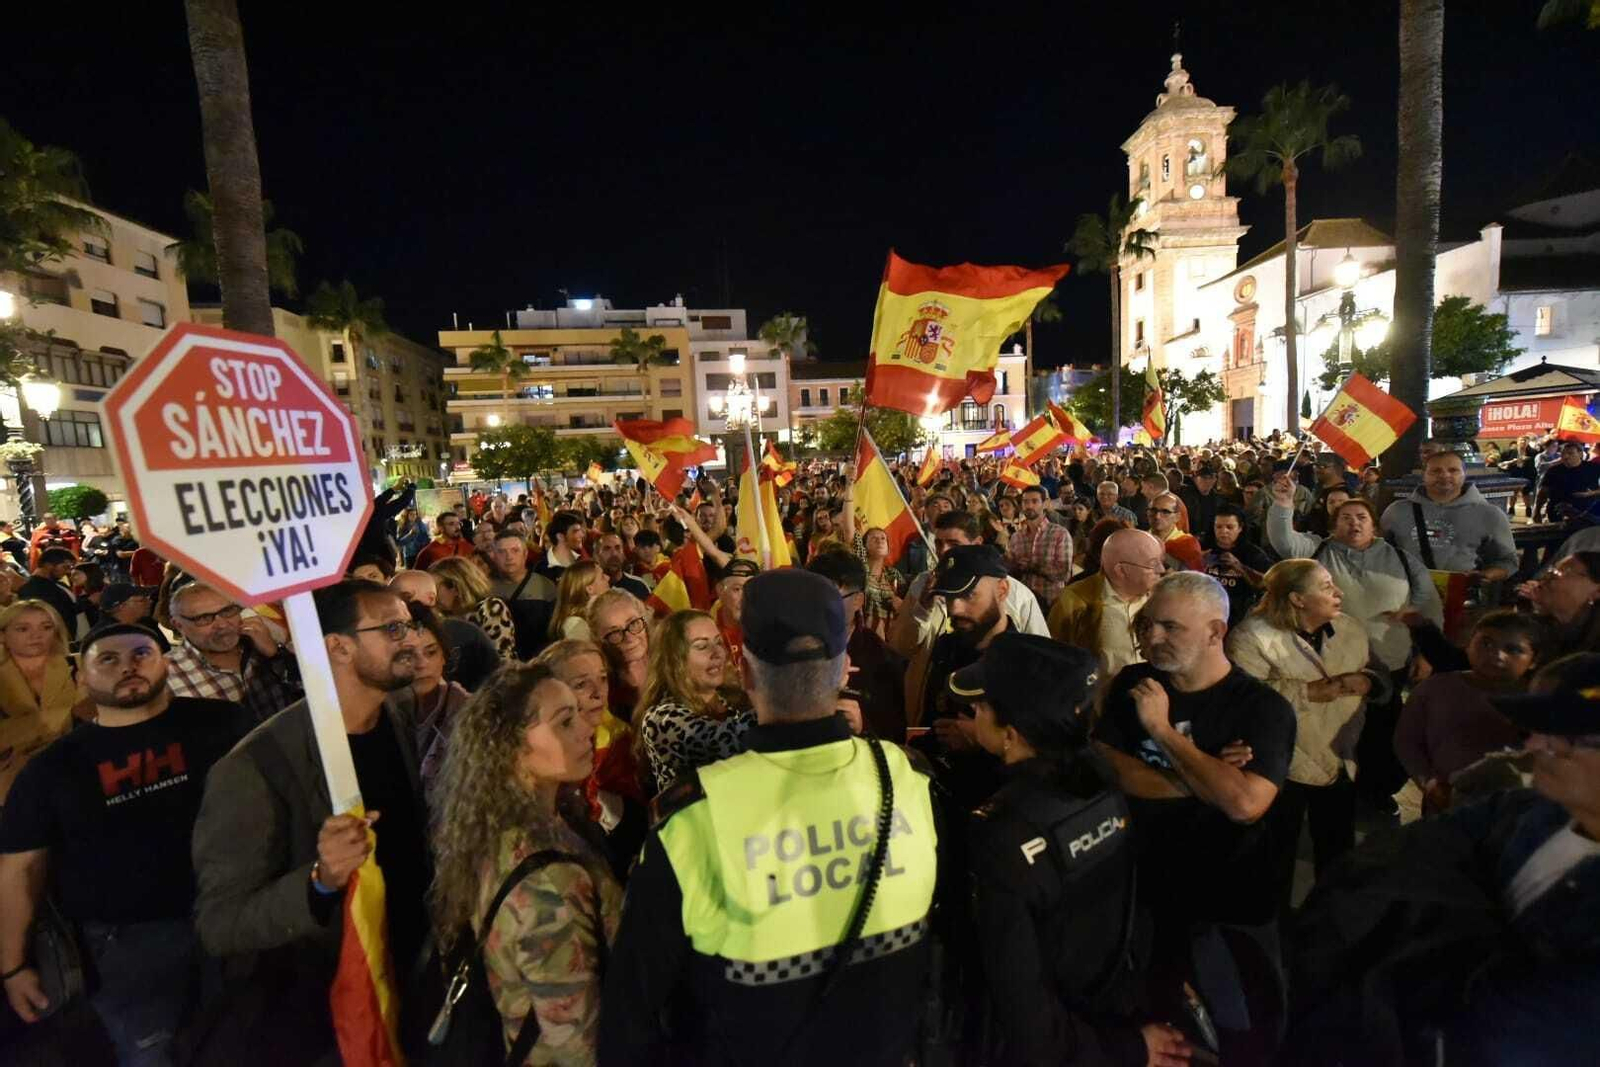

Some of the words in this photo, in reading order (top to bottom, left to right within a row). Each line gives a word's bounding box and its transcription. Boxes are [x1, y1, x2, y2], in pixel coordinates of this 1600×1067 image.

[211, 357, 281, 401] STOP
[162, 391, 331, 459] SÁNCHEZ
[1487, 404, 1538, 421] ¡HOLA!
[174, 472, 352, 535] ELECCIONES
[257, 524, 318, 576] ¡YA!
[106, 788, 141, 806] HELLY
[144, 774, 188, 793] HANSEN
[743, 807, 913, 870] POLICA
[1020, 836, 1047, 865] P
